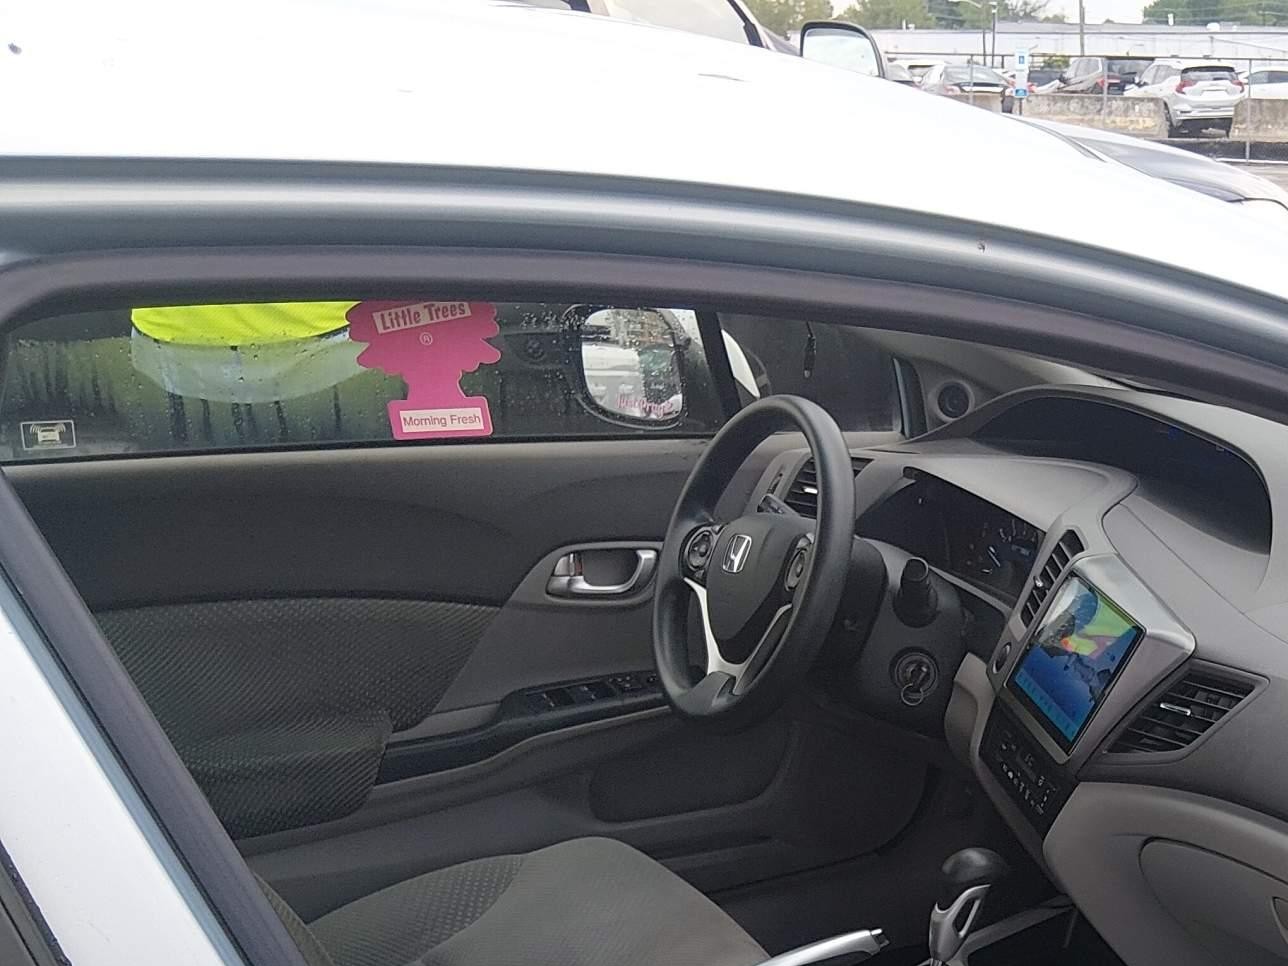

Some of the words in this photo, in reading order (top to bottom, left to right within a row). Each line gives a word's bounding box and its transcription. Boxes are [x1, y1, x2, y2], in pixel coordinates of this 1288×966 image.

[380, 307, 421, 331] Little
[423, 303, 466, 322] Trees
[402, 415, 448, 428] Morning
[448, 412, 482, 425] Fresh
